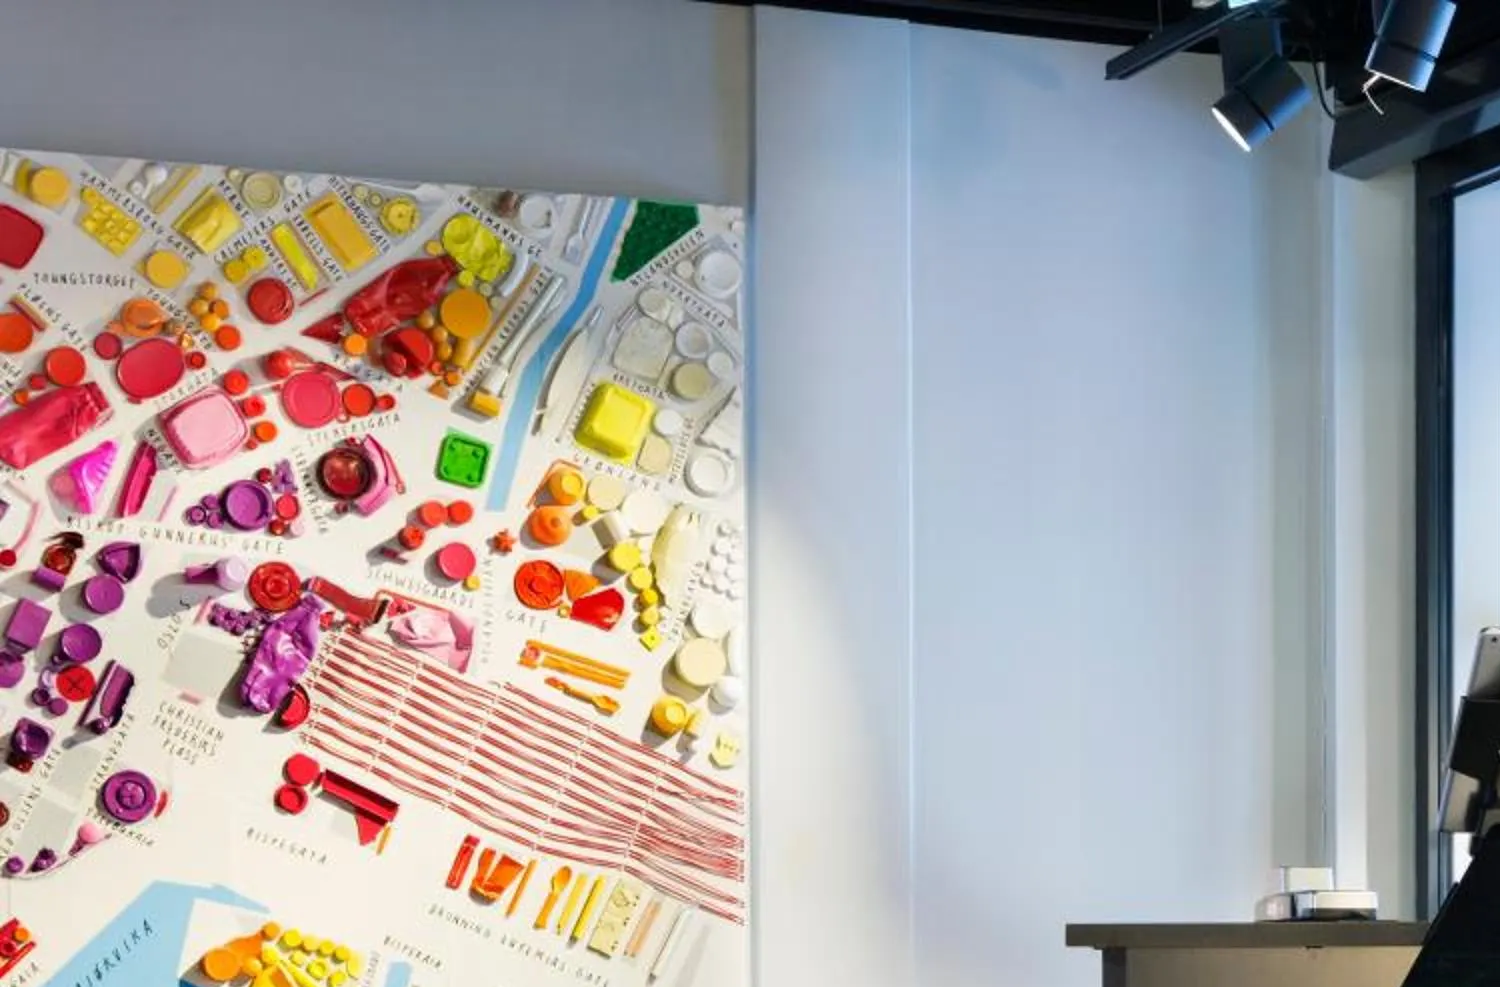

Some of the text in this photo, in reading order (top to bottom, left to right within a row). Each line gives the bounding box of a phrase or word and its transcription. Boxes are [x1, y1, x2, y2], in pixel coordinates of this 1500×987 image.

[33, 271, 137, 289] YOUNGSTORGET
[241, 537, 285, 554] GATE
[506, 610, 549, 634] GATE
[159, 702, 224, 742] CHRISTIAN
